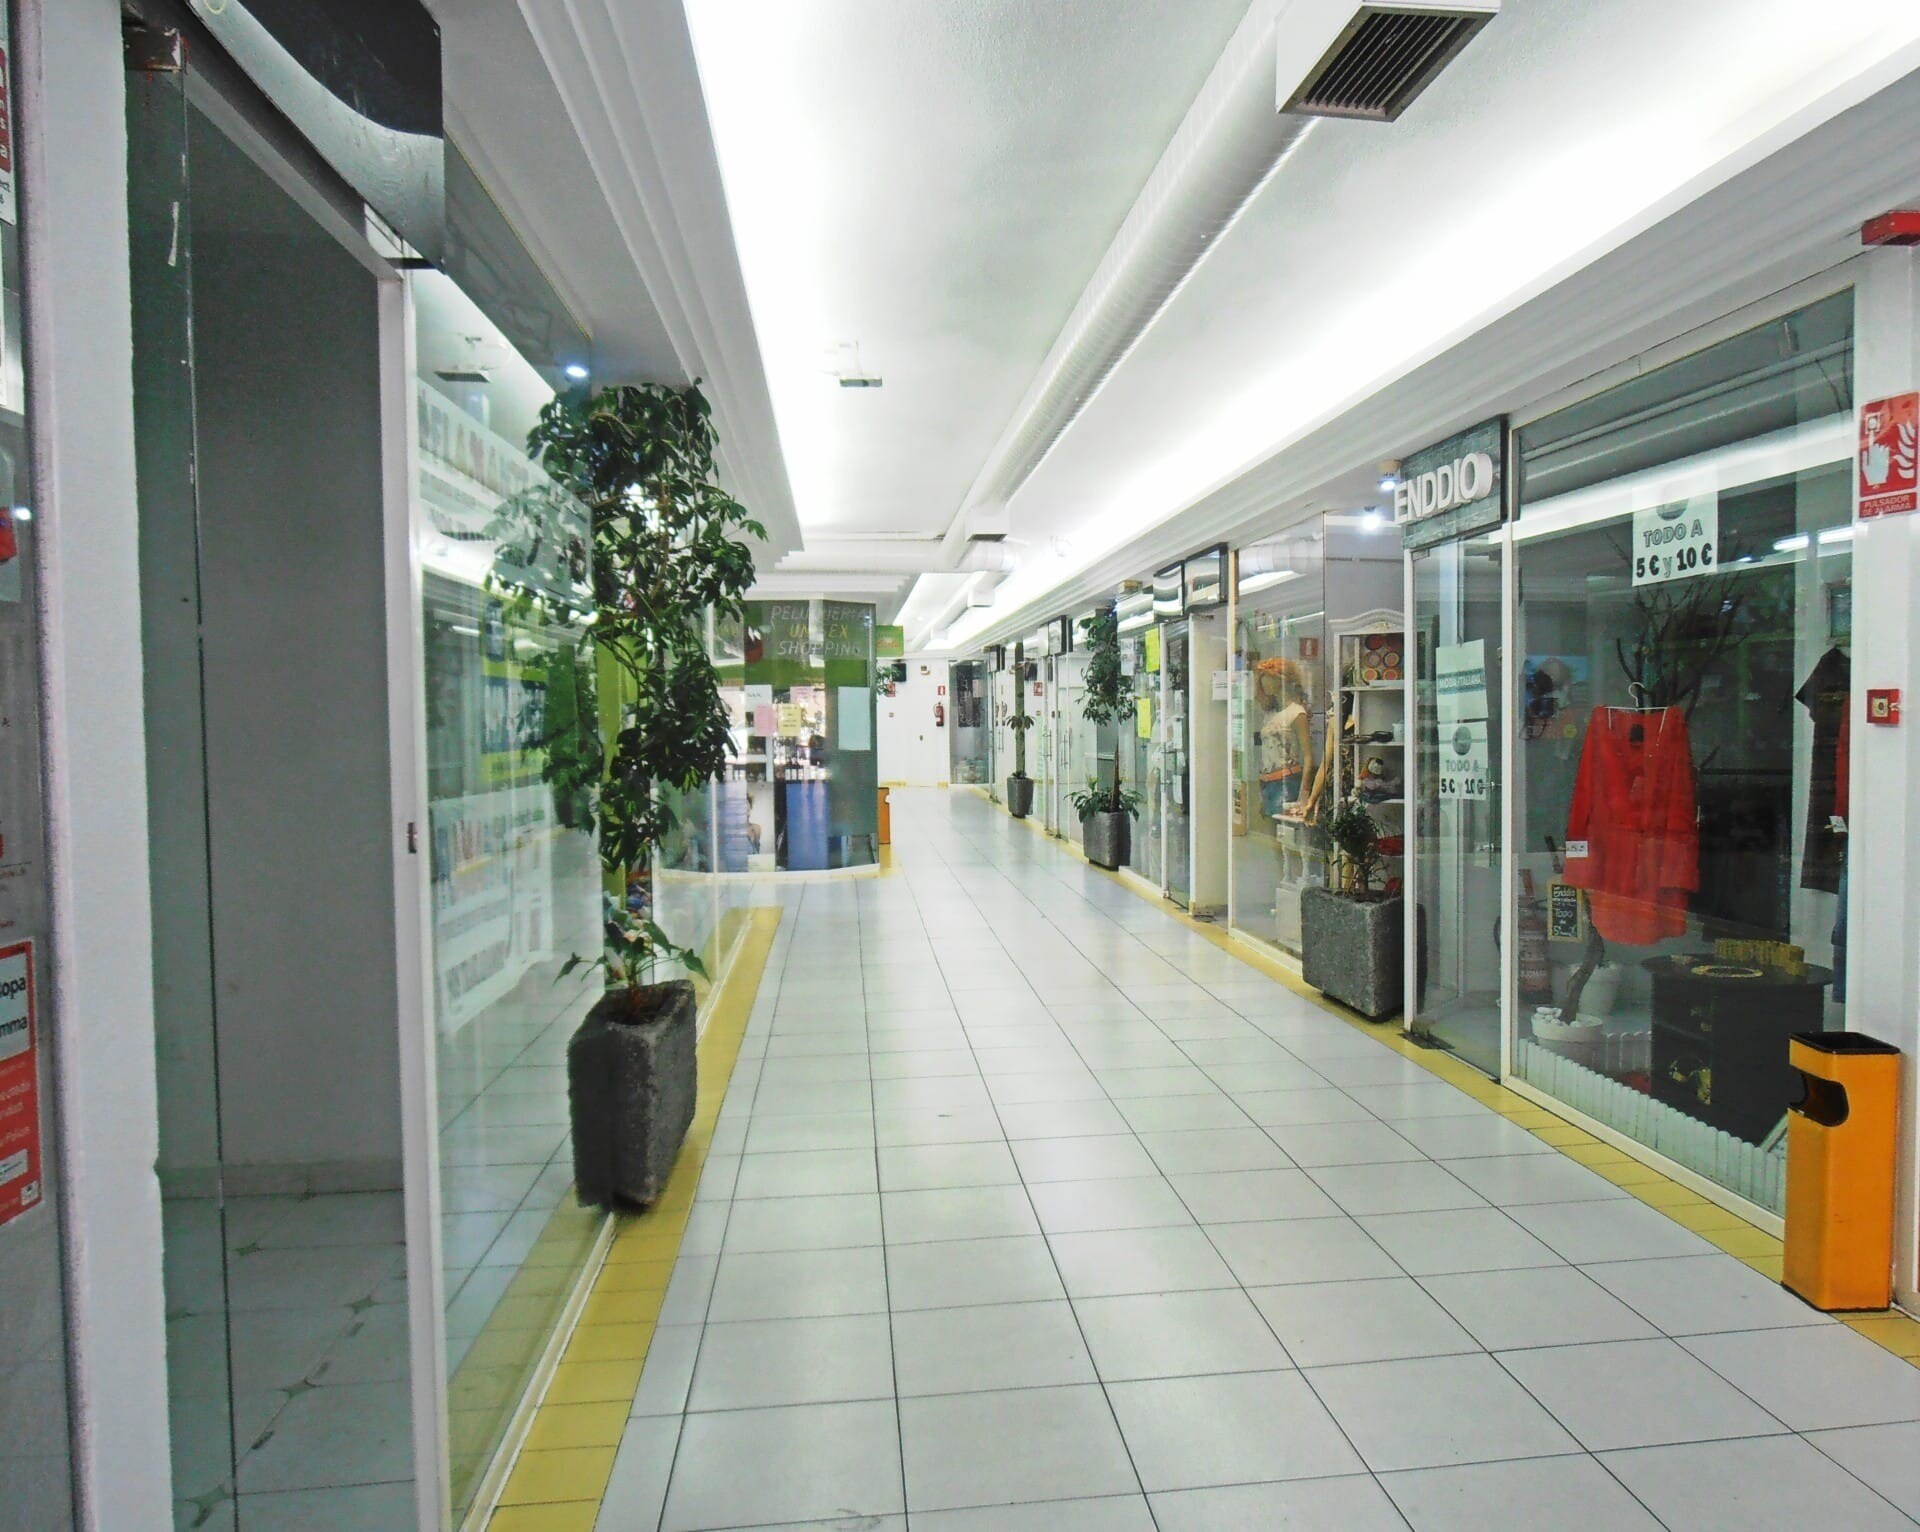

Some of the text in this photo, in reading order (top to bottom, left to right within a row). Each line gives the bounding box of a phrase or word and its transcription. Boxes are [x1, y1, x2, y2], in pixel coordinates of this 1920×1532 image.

[1394, 453, 1492, 526] ENDDIO
[1865, 495, 1910, 508] PULSADOR
[1862, 502, 1911, 517] DE ALARMA
[1643, 519, 1704, 548] TODO A
[1636, 542, 1712, 578] 5 € y 10 €
[1445, 759, 1480, 772] TODO A
[1441, 778, 1447, 793] 5
